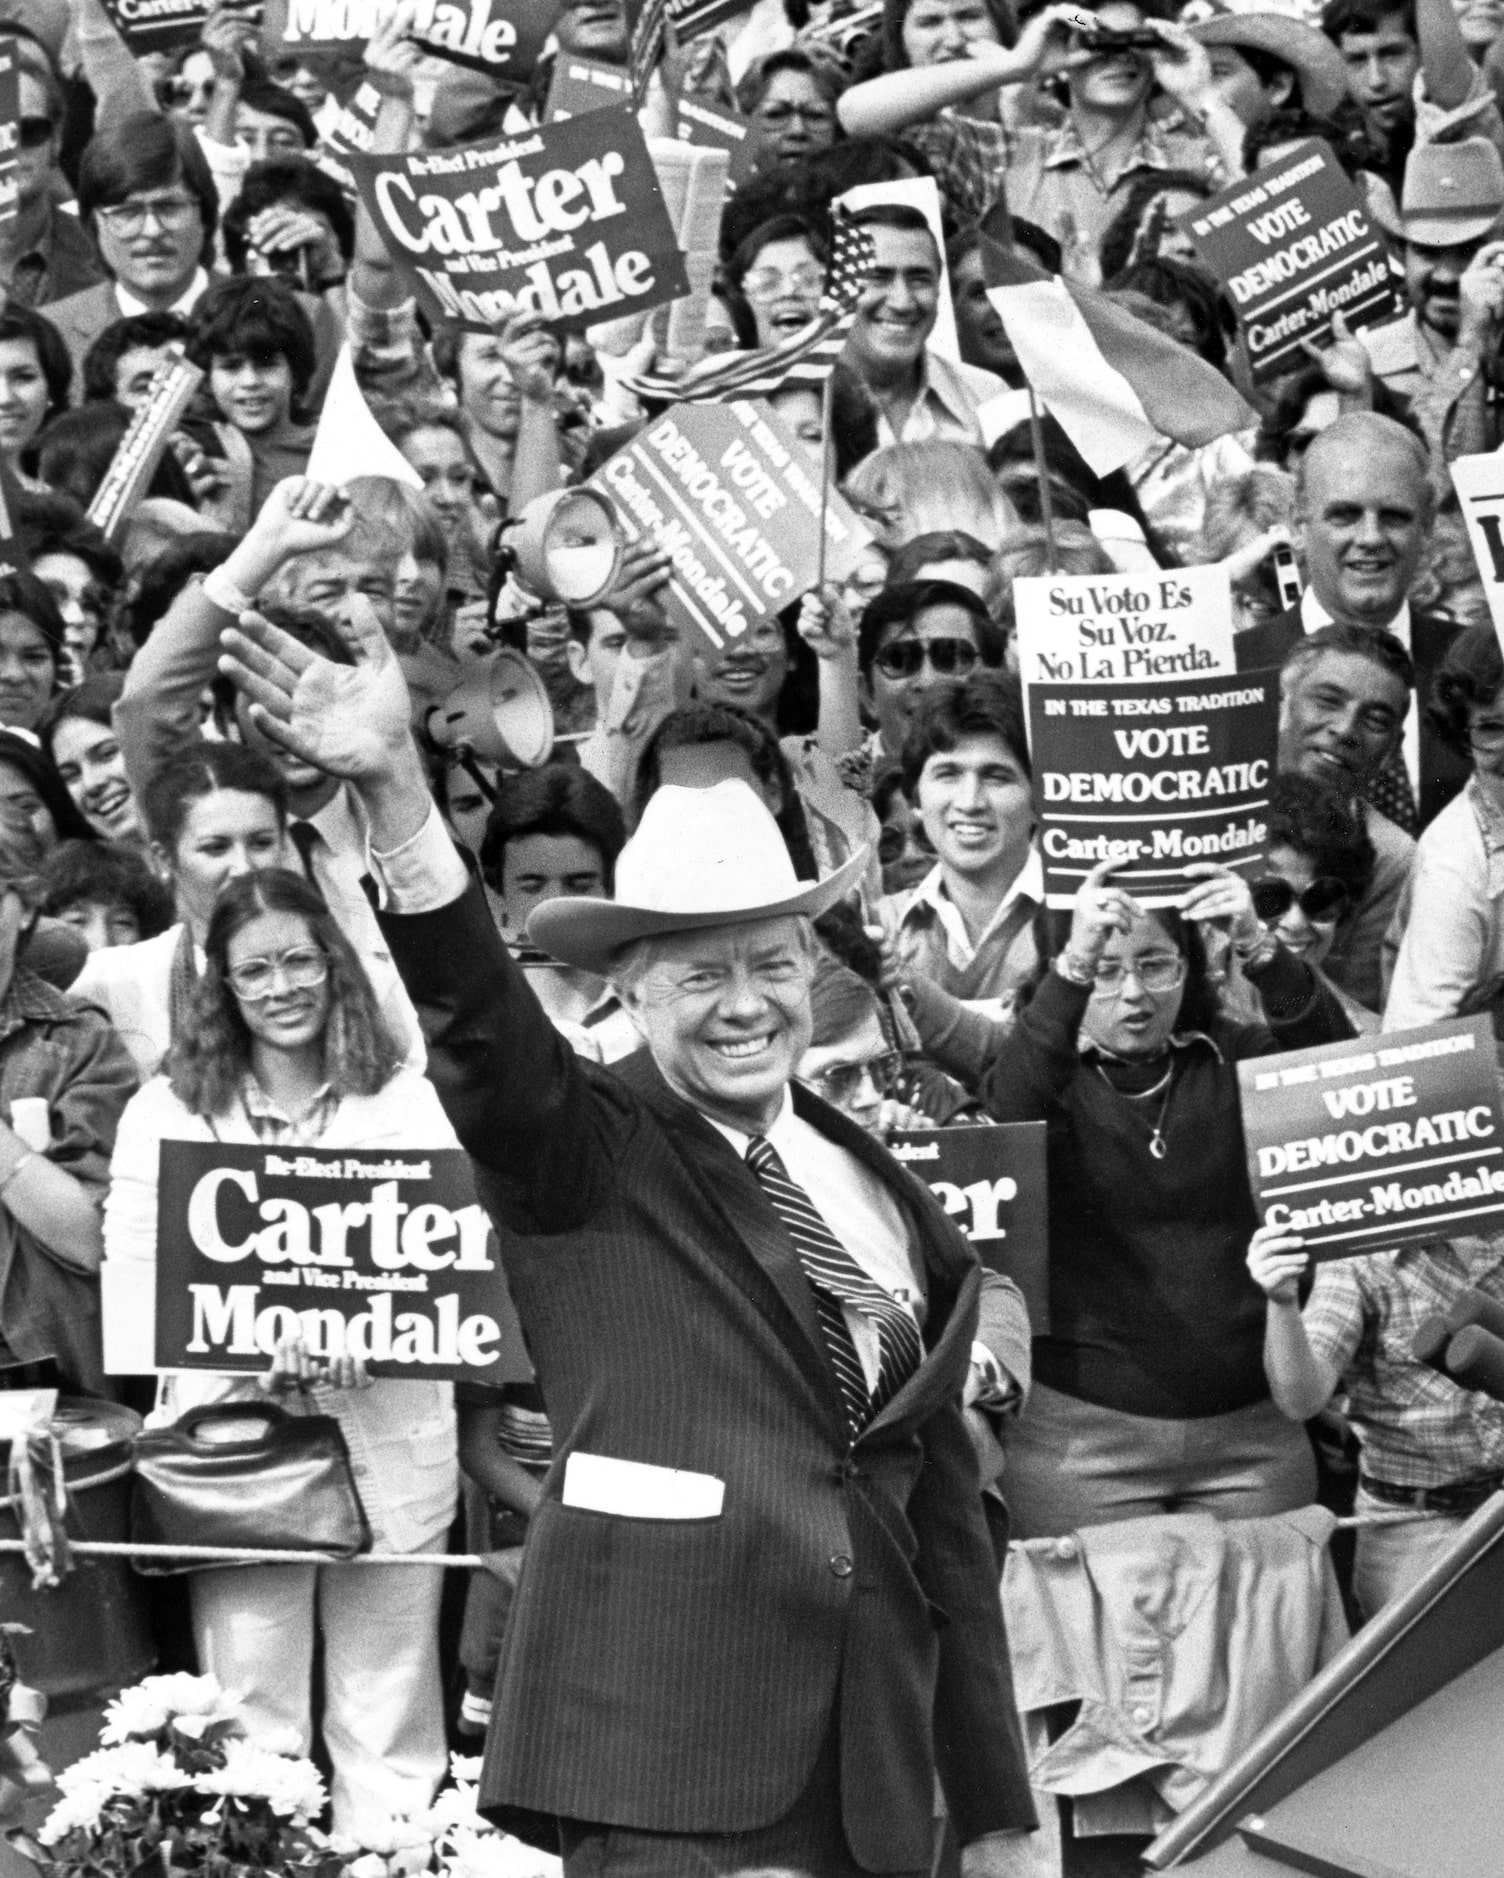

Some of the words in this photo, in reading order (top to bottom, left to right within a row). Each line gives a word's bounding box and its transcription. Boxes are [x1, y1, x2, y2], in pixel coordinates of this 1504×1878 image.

[464, 134, 545, 169] President
[375, 151, 627, 254] Carter
[1247, 198, 1311, 244] VOTE
[497, 235, 575, 269] President
[1228, 209, 1369, 303] DEMOCRATIC
[1248, 261, 1388, 352] Carter-Mondale
[720, 438, 788, 520] VOTE
[648, 419, 795, 598] DEMOCRATIC
[1049, 588, 1084, 616] Su
[1087, 587, 1150, 615] Voto
[1158, 580, 1193, 610] Es
[1078, 618, 1115, 647] Su
[1119, 616, 1176, 645] Voz.
[1036, 652, 1073, 680] No
[1079, 652, 1115, 679] La
[1122, 643, 1220, 678] Pierda.
[1044, 699, 1066, 716] IN
[1069, 699, 1108, 716] THE
[1111, 698, 1172, 716] TEXAS
[1176, 687, 1265, 713] TRADITION
[1114, 725, 1210, 759] VOTE
[1042, 759, 1269, 802] DEMOCRATIC
[1043, 819, 1268, 860] Carter-Mondale
[1322, 1075, 1418, 1119] VOTE
[1257, 1106, 1495, 1177] DEMOCRATIC
[266, 1155, 342, 1178] Re-Elect
[344, 1159, 432, 1179] President
[188, 1167, 495, 1271] Carter
[1264, 1166, 1504, 1231] Carter-Mondale
[262, 1267, 299, 1285] and
[302, 1267, 341, 1287] Vice
[343, 1270, 428, 1291] President
[186, 1283, 501, 1366] Mondale
